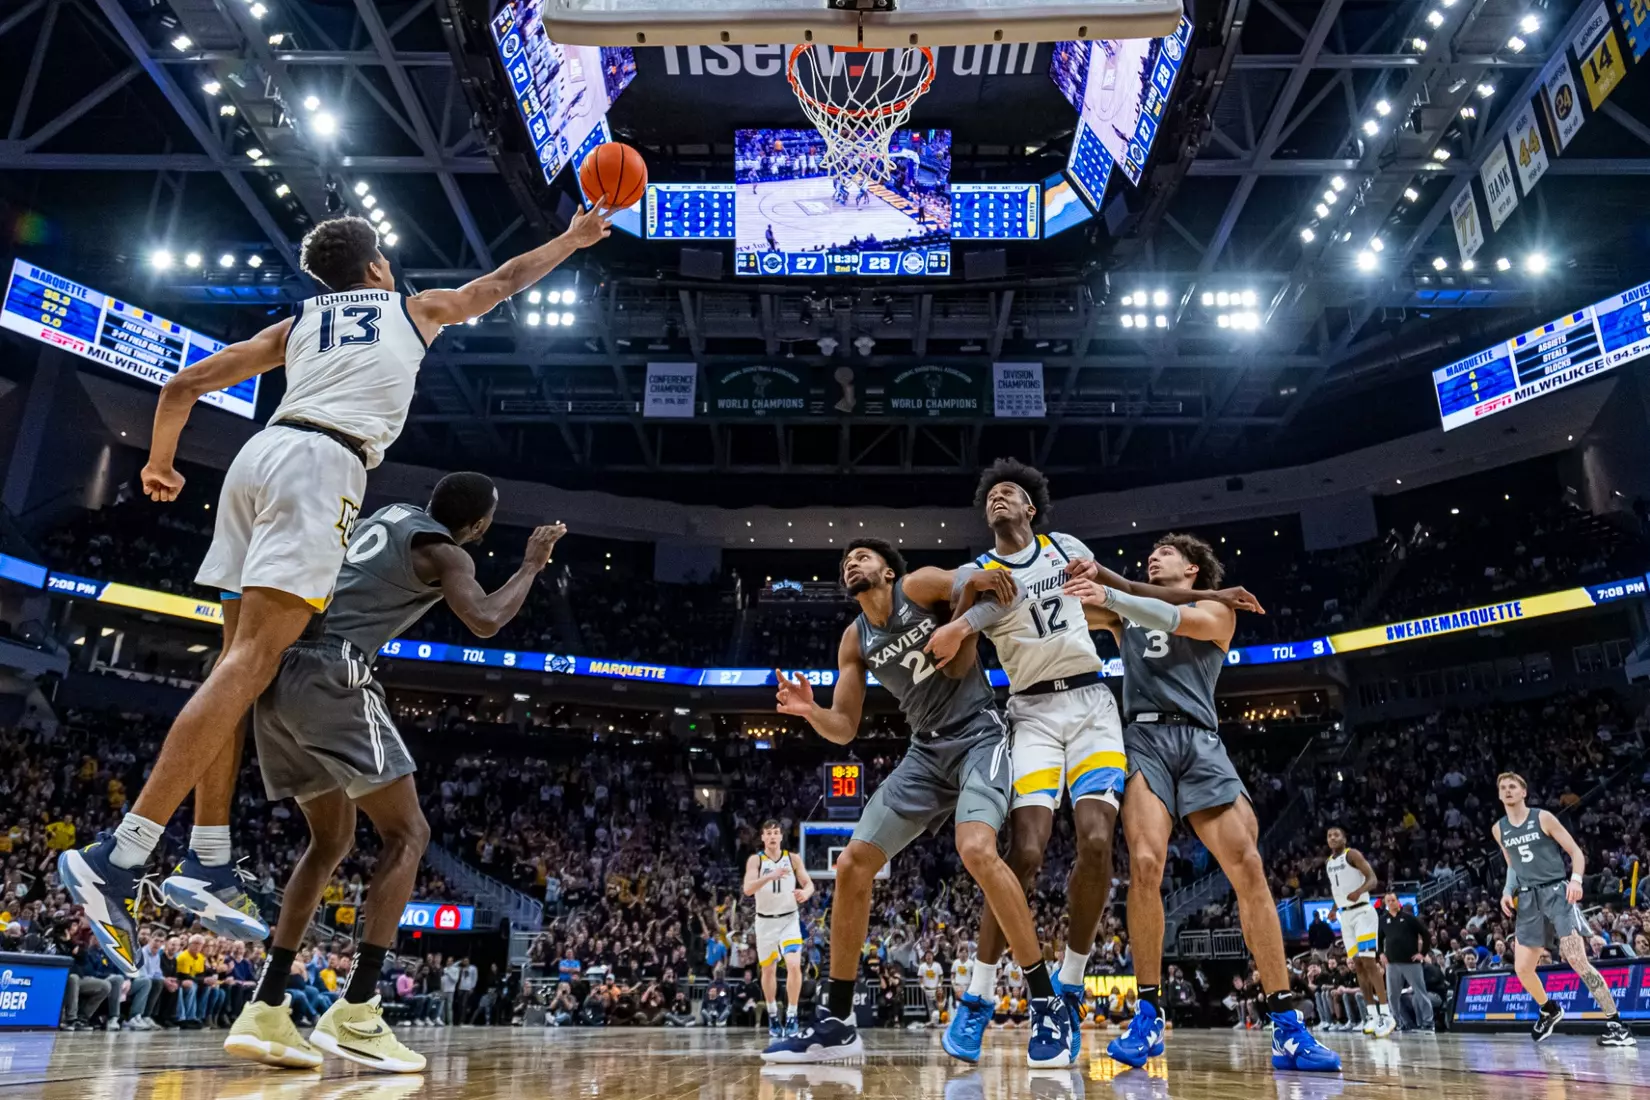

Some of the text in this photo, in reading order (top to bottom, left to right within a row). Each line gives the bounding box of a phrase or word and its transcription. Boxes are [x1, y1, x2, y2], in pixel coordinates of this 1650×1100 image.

[1589, 41, 1613, 84] 14
[512, 62, 527, 84] 27
[1157, 63, 1170, 89] 28
[1555, 86, 1572, 117] 24
[533, 117, 547, 141] 28
[1139, 123, 1152, 143] 27
[1519, 126, 1540, 168] 44
[1488, 164, 1511, 204] HANK
[1456, 201, 1476, 248] 77
[796, 257, 817, 270] 27
[827, 254, 859, 264] 18:39
[868, 257, 891, 270] 28
[29, 267, 88, 299] MARQUETTE
[315, 292, 390, 306] IGHODARO
[41, 313, 62, 328] 0.0
[122, 320, 143, 334] FIELD
[318, 304, 381, 352] 13
[1538, 334, 1567, 353] ASSISTS
[40, 327, 172, 384] ESPN MILWAUKE
[1446, 350, 1494, 377] MARQUETTE
[1542, 346, 1568, 363] STEALS
[649, 374, 694, 384] CONFERENCE
[998, 379, 1040, 389] CHAMPIONS
[1003, 370, 1034, 380] DIVISION
[650, 384, 692, 393] CHAMPIONS
[1474, 394, 1512, 417] ESPN
[1514, 358, 1605, 401] MILWAUKEE
[718, 399, 804, 409] WORLD CHAMPIONS
[891, 399, 977, 409] WORLD CHAMPIONS
[346, 524, 388, 563] 0
[48, 577, 96, 595] 7:08 PM
[1597, 582, 1646, 600] 7:08 PM
[1028, 596, 1069, 639] 12
[1386, 601, 1523, 640] #WEAREMARQUETTE
[418, 644, 432, 658] 0
[869, 617, 937, 668] XAVIER
[1143, 630, 1170, 658] 3
[1312, 640, 1325, 655] 3
[462, 648, 516, 666] TOL 3
[1227, 650, 1240, 664] 0
[1272, 646, 1297, 660] TOL
[589, 661, 666, 679] MARQUETTE
[900, 651, 936, 685] 2
[720, 671, 742, 684] 27
[832, 765, 859, 778] 18:39
[832, 777, 857, 797] 30
[1504, 832, 1541, 847] XAVIER
[1518, 845, 1534, 863] 5
[773, 880, 781, 893] 11
[400, 909, 429, 926] MO
[1467, 977, 1497, 995] ESPN
[1546, 972, 1580, 992] ESPN
[0, 991, 28, 1011] BER
[1465, 994, 1494, 1003] MILWAUKEE
[1546, 990, 1577, 1001] LWAUKEE
